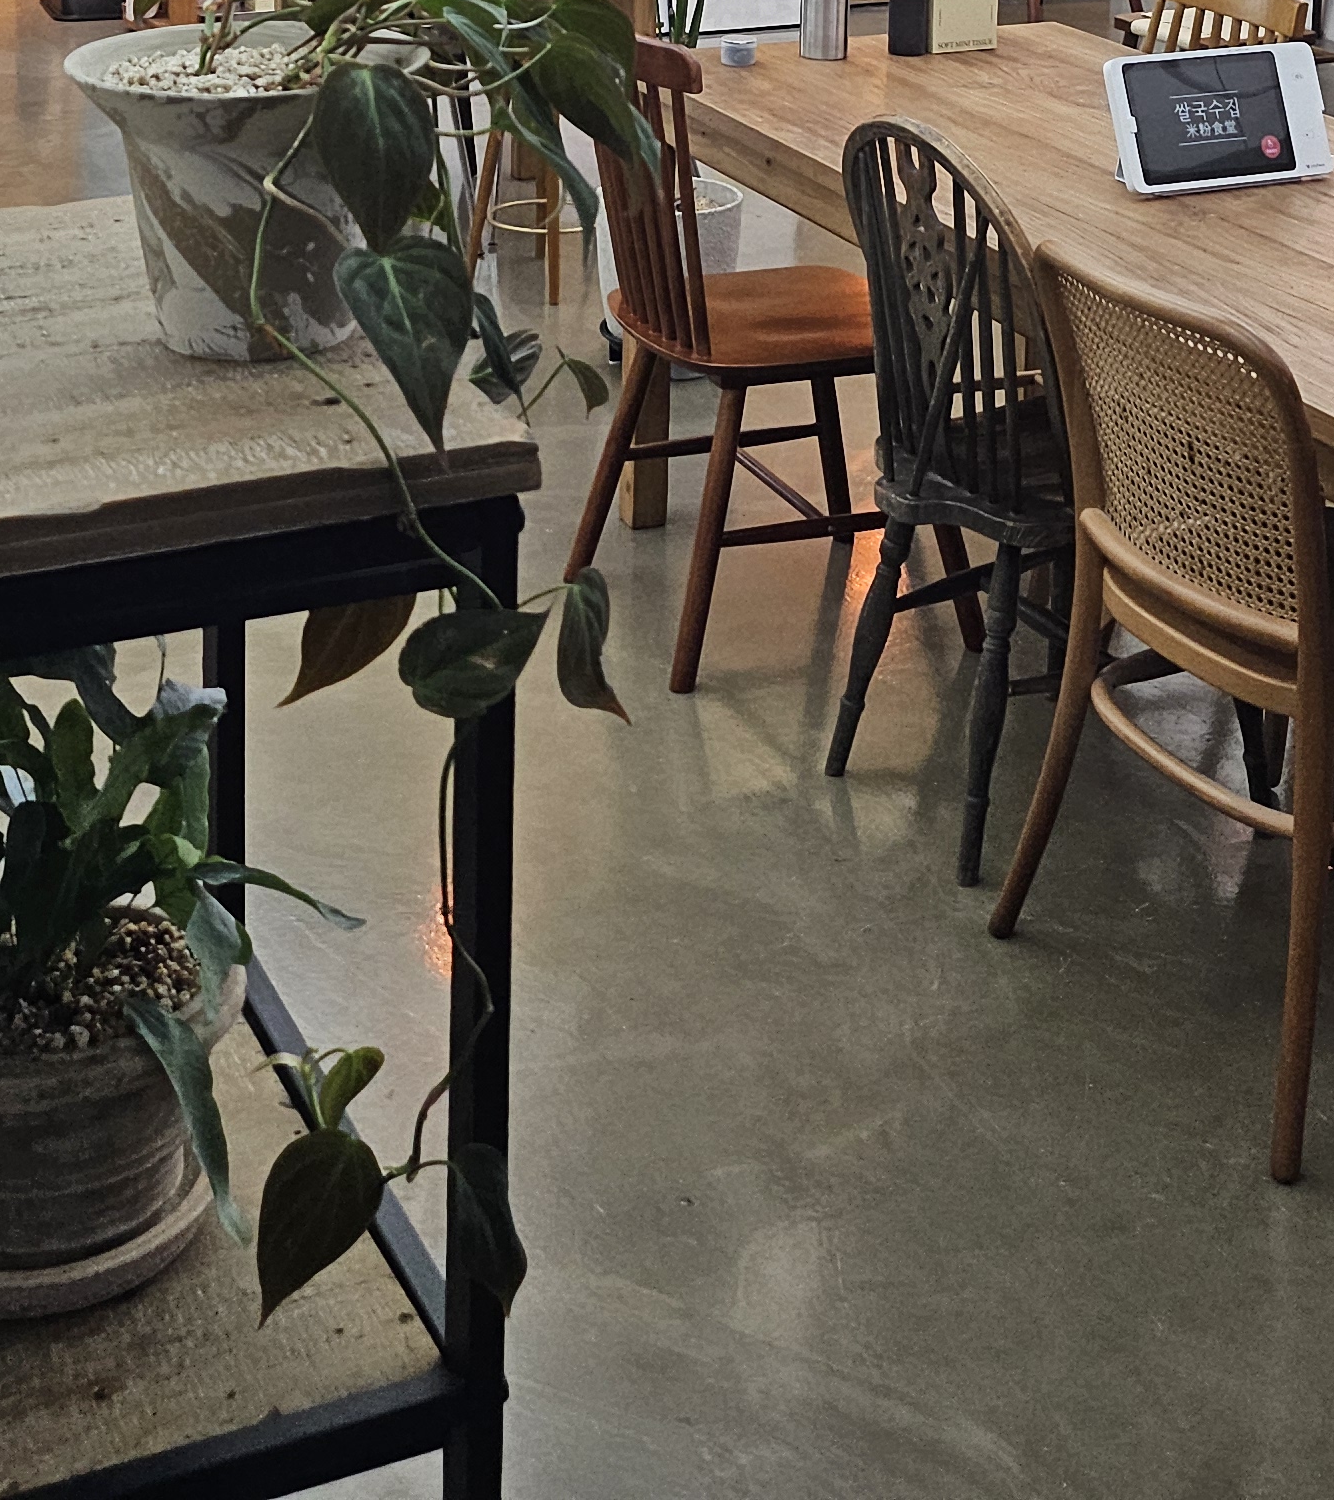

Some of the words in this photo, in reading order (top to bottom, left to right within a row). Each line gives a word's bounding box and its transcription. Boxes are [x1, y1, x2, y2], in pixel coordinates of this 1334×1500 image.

[1173, 96, 1240, 123] 쌀국수집
[1186, 119, 1238, 138] 米粉食堂
